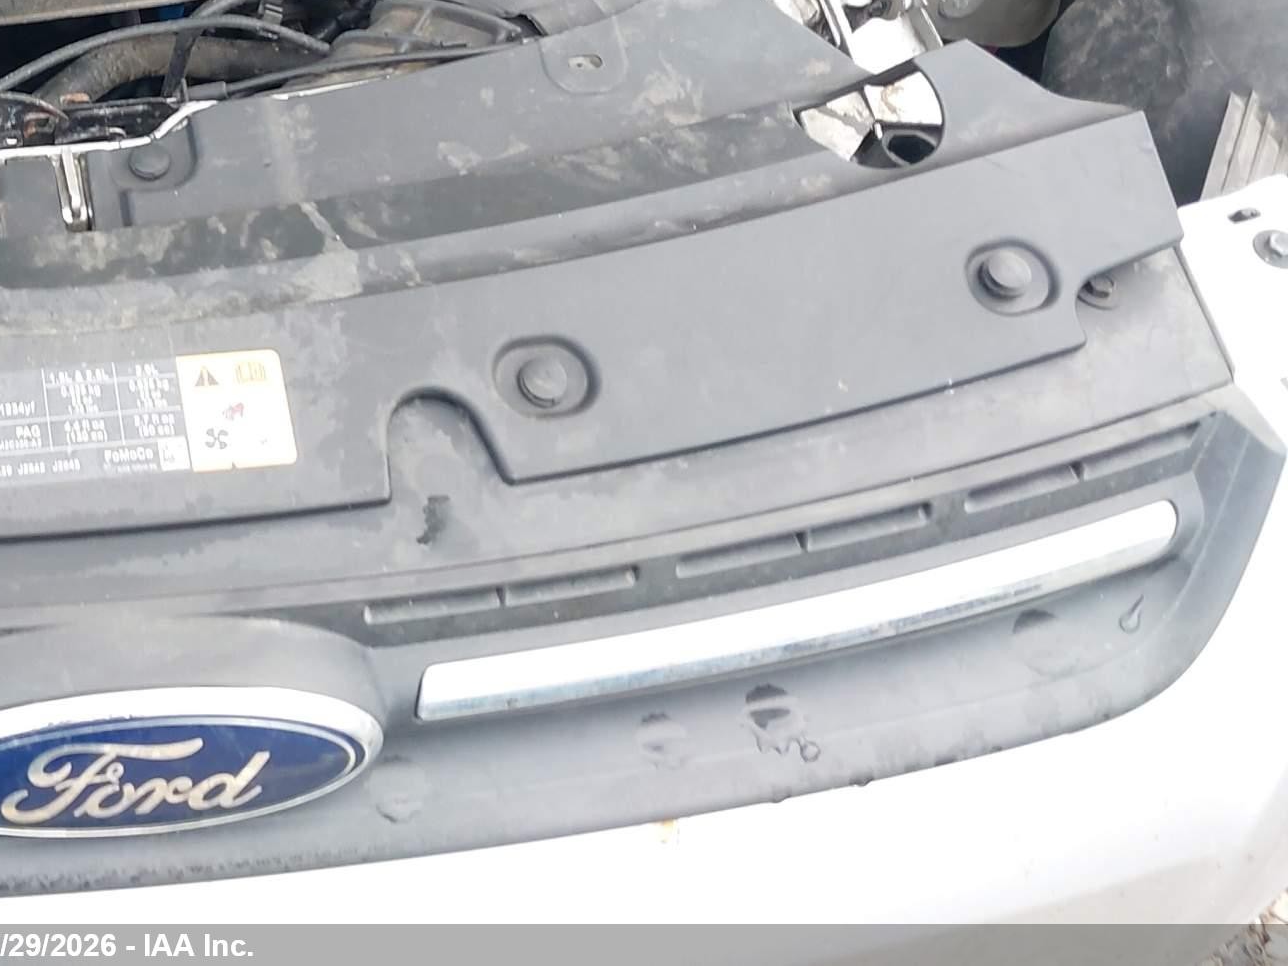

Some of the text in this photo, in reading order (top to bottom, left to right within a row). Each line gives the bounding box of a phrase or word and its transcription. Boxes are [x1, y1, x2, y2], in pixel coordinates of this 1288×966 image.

[15, 424, 41, 439] PAG
[103, 446, 154, 465] FoMoCo
[0, 736, 271, 825] Ford
